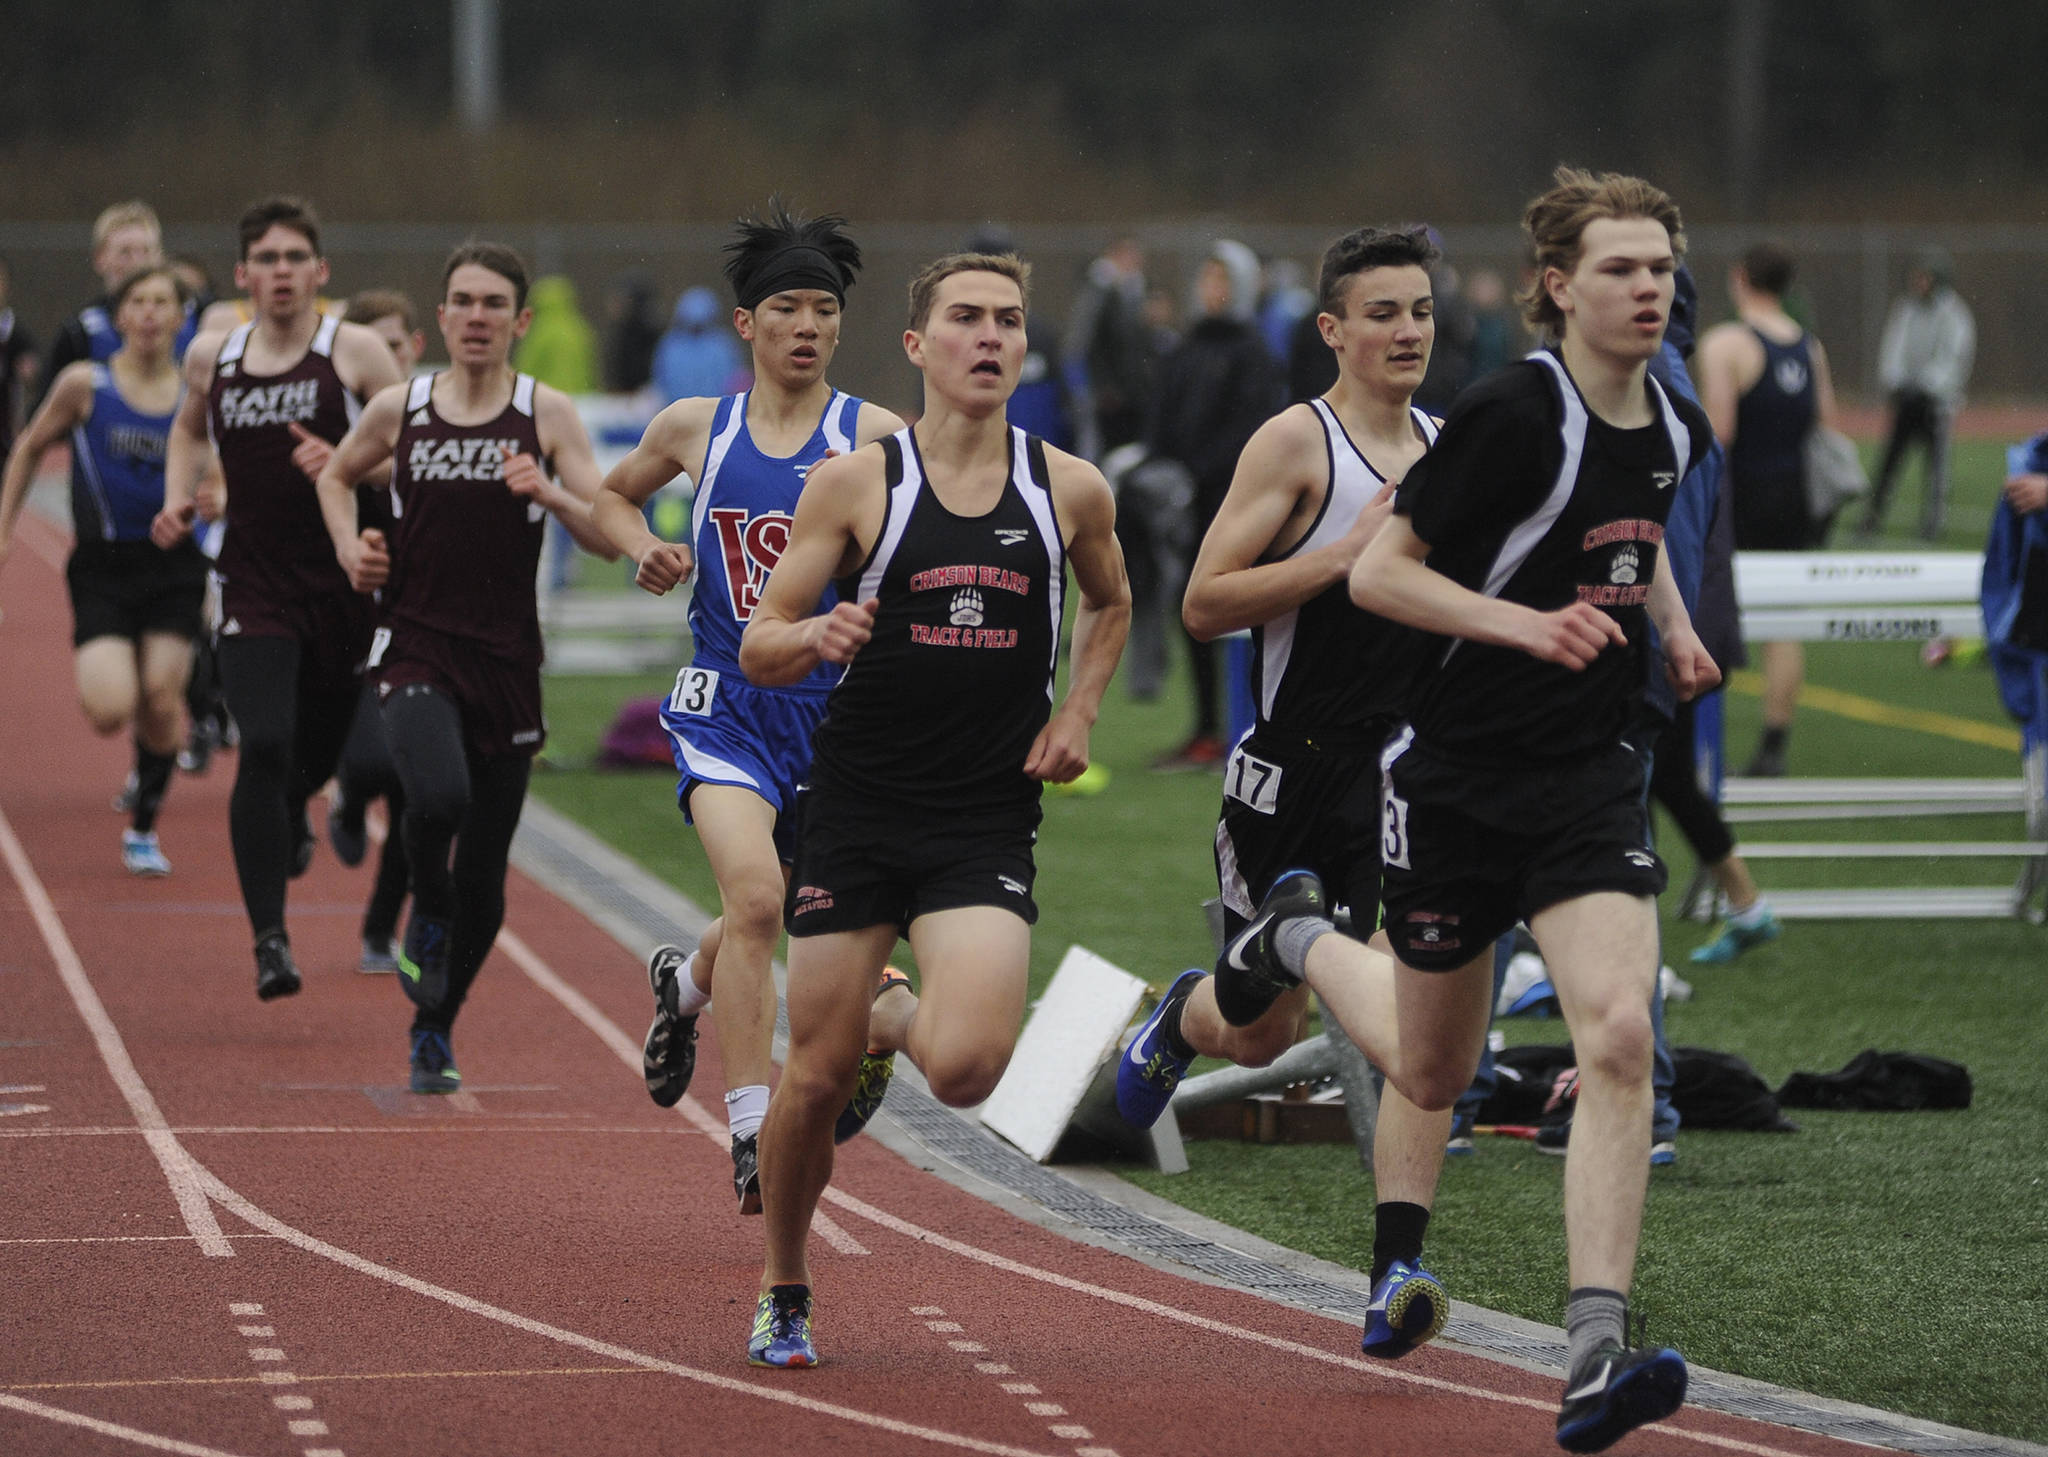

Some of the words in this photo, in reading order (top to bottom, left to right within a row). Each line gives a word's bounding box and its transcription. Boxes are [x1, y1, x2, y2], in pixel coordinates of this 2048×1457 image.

[1583, 518, 1639, 551] CRIMSON
[910, 565, 977, 592] CRIMSON
[979, 566, 1030, 596] BEARS
[911, 624, 960, 647] TRACK
[975, 629, 1018, 648] FIELD
[1235, 755, 1273, 806] 17
[1385, 799, 1399, 861] 3
